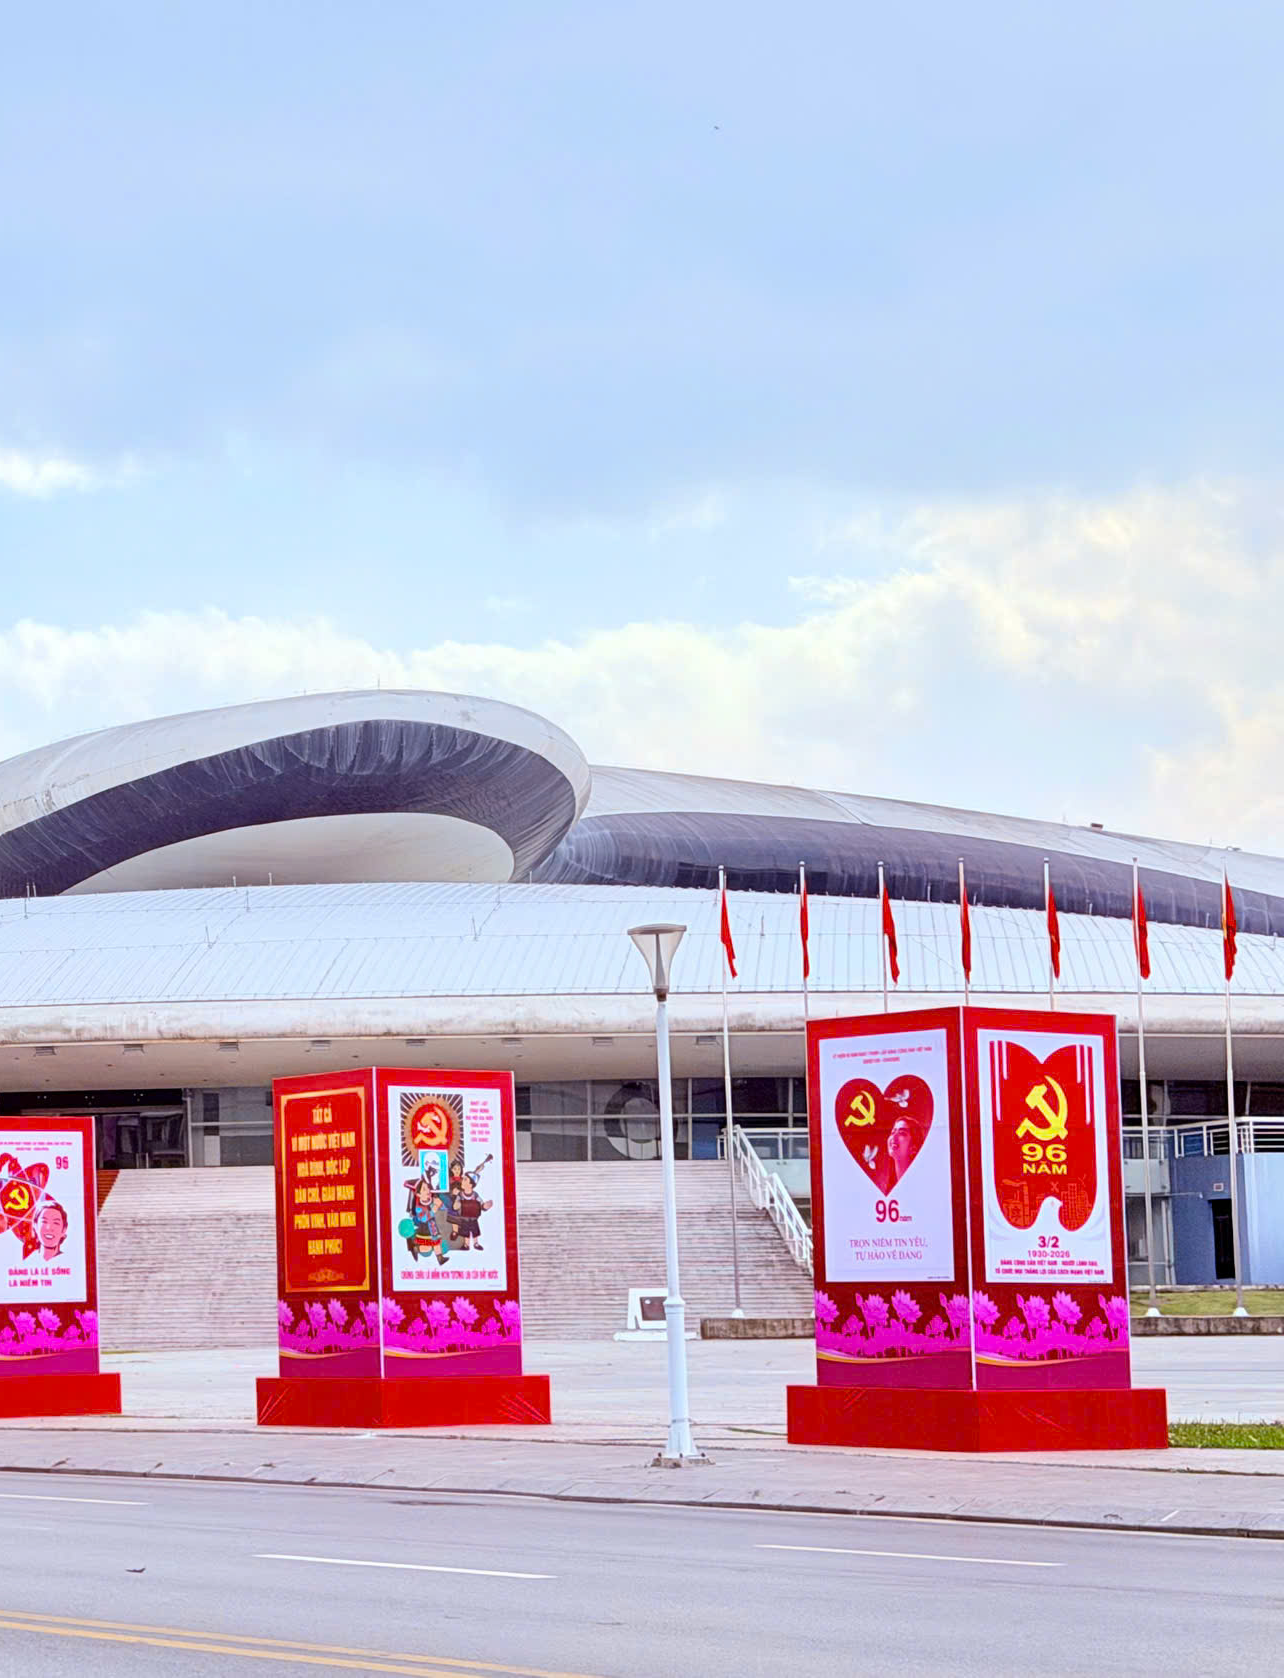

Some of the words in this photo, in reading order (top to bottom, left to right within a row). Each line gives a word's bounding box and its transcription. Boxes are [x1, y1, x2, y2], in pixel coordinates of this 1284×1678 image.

[1021, 1143, 1068, 1162] 96
[55, 1156, 69, 1170] 96
[1022, 1161, 1068, 1175] NĂM
[875, 1199, 899, 1222] 96
[893, 1238, 907, 1247] TIN
[1038, 1235, 1059, 1248] 3/2
[1028, 1250, 1070, 1258] 1930-2026
